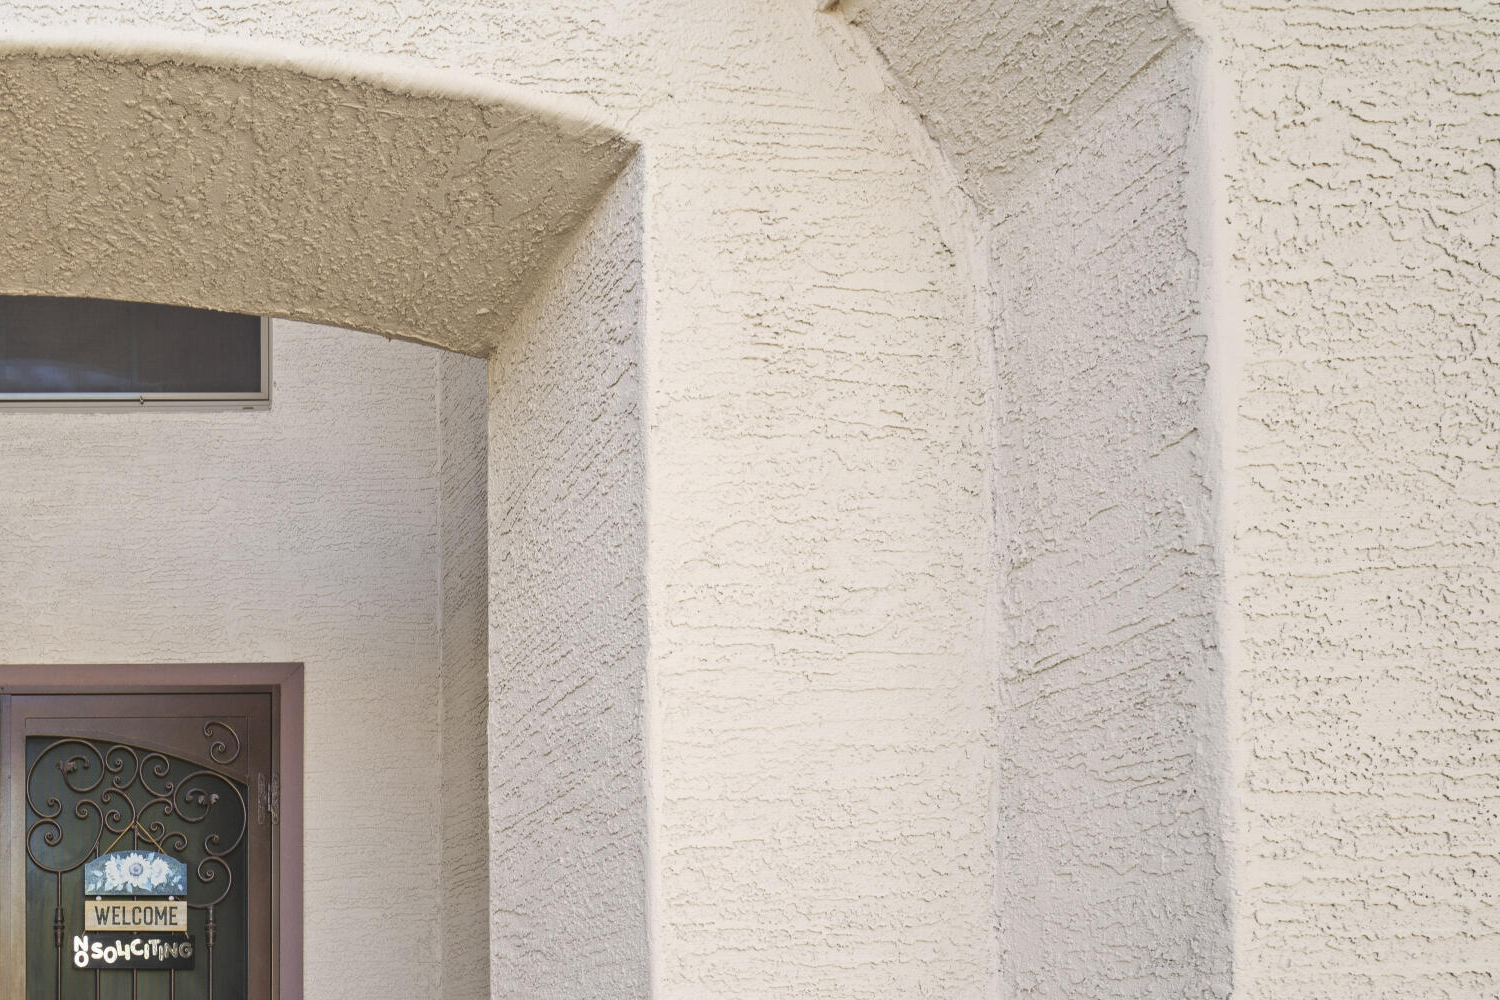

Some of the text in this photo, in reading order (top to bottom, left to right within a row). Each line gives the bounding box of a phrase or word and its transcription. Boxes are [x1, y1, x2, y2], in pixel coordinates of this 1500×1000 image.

[94, 906, 178, 926] WELCOME
[73, 935, 193, 967] NO SOLICITING
